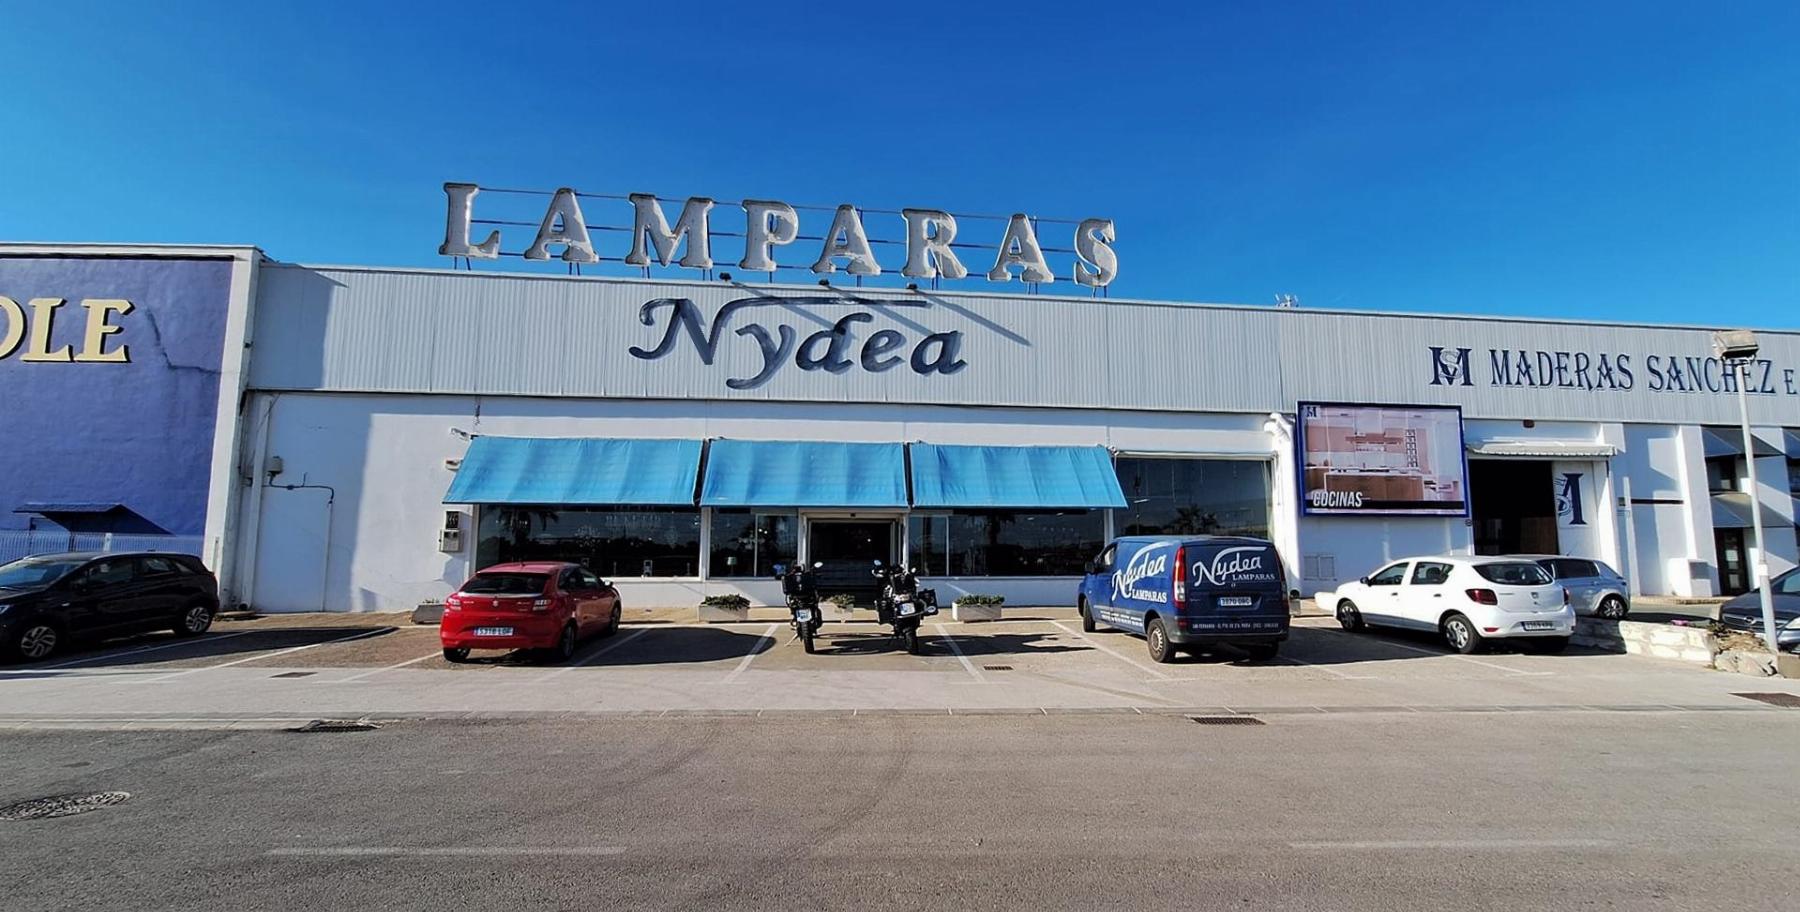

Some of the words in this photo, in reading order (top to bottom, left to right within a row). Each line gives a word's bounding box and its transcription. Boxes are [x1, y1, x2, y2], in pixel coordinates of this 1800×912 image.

[438, 182, 1118, 288] LAMPARAS
[628, 296, 968, 390] Nydea
[1488, 349, 1634, 392] MADERAS
[1645, 354, 1777, 394] SANCHEZ
[1311, 490, 1364, 508] COCINAS
[1111, 541, 1174, 602] Nydea
[1192, 546, 1267, 588] Nydea
[1231, 572, 1276, 582] LAMPARAS
[1131, 588, 1168, 604] LAMPARAS
